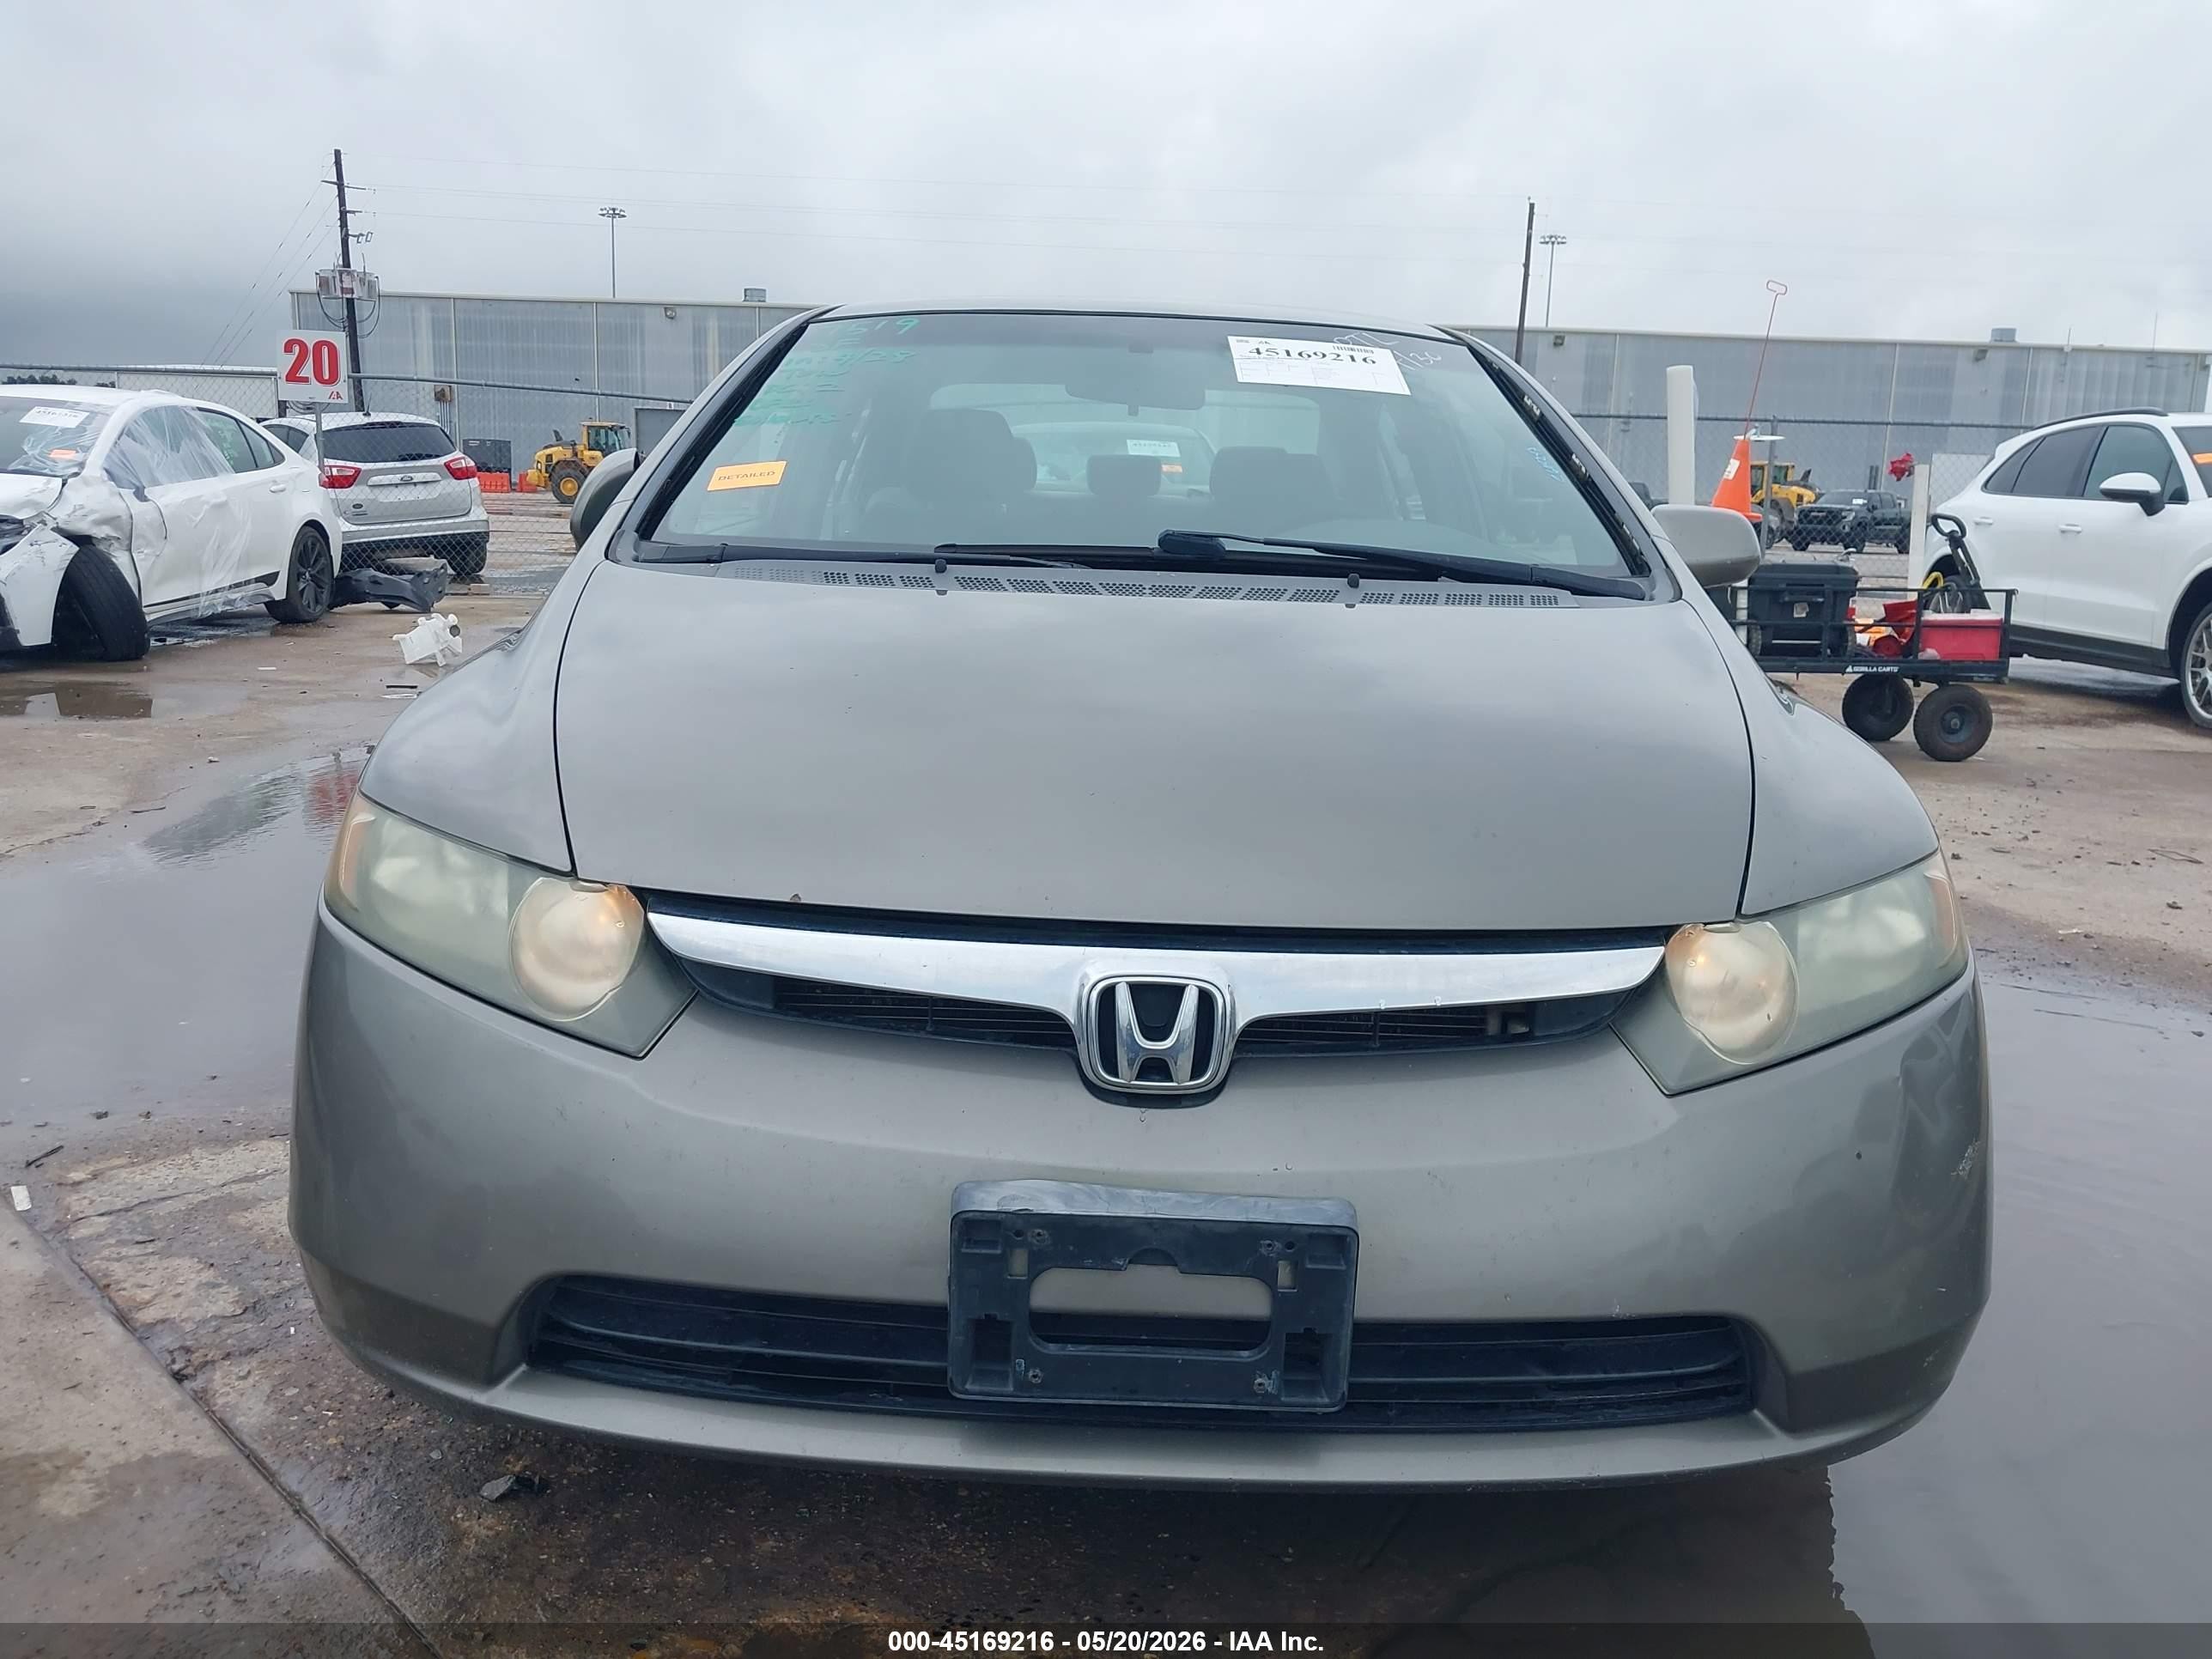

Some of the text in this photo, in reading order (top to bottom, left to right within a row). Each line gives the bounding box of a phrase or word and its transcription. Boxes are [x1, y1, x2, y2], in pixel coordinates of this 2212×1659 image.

[283, 337, 340, 387] 20
[1248, 346, 1377, 366] 45169216
[718, 470, 776, 483] DETAILED
